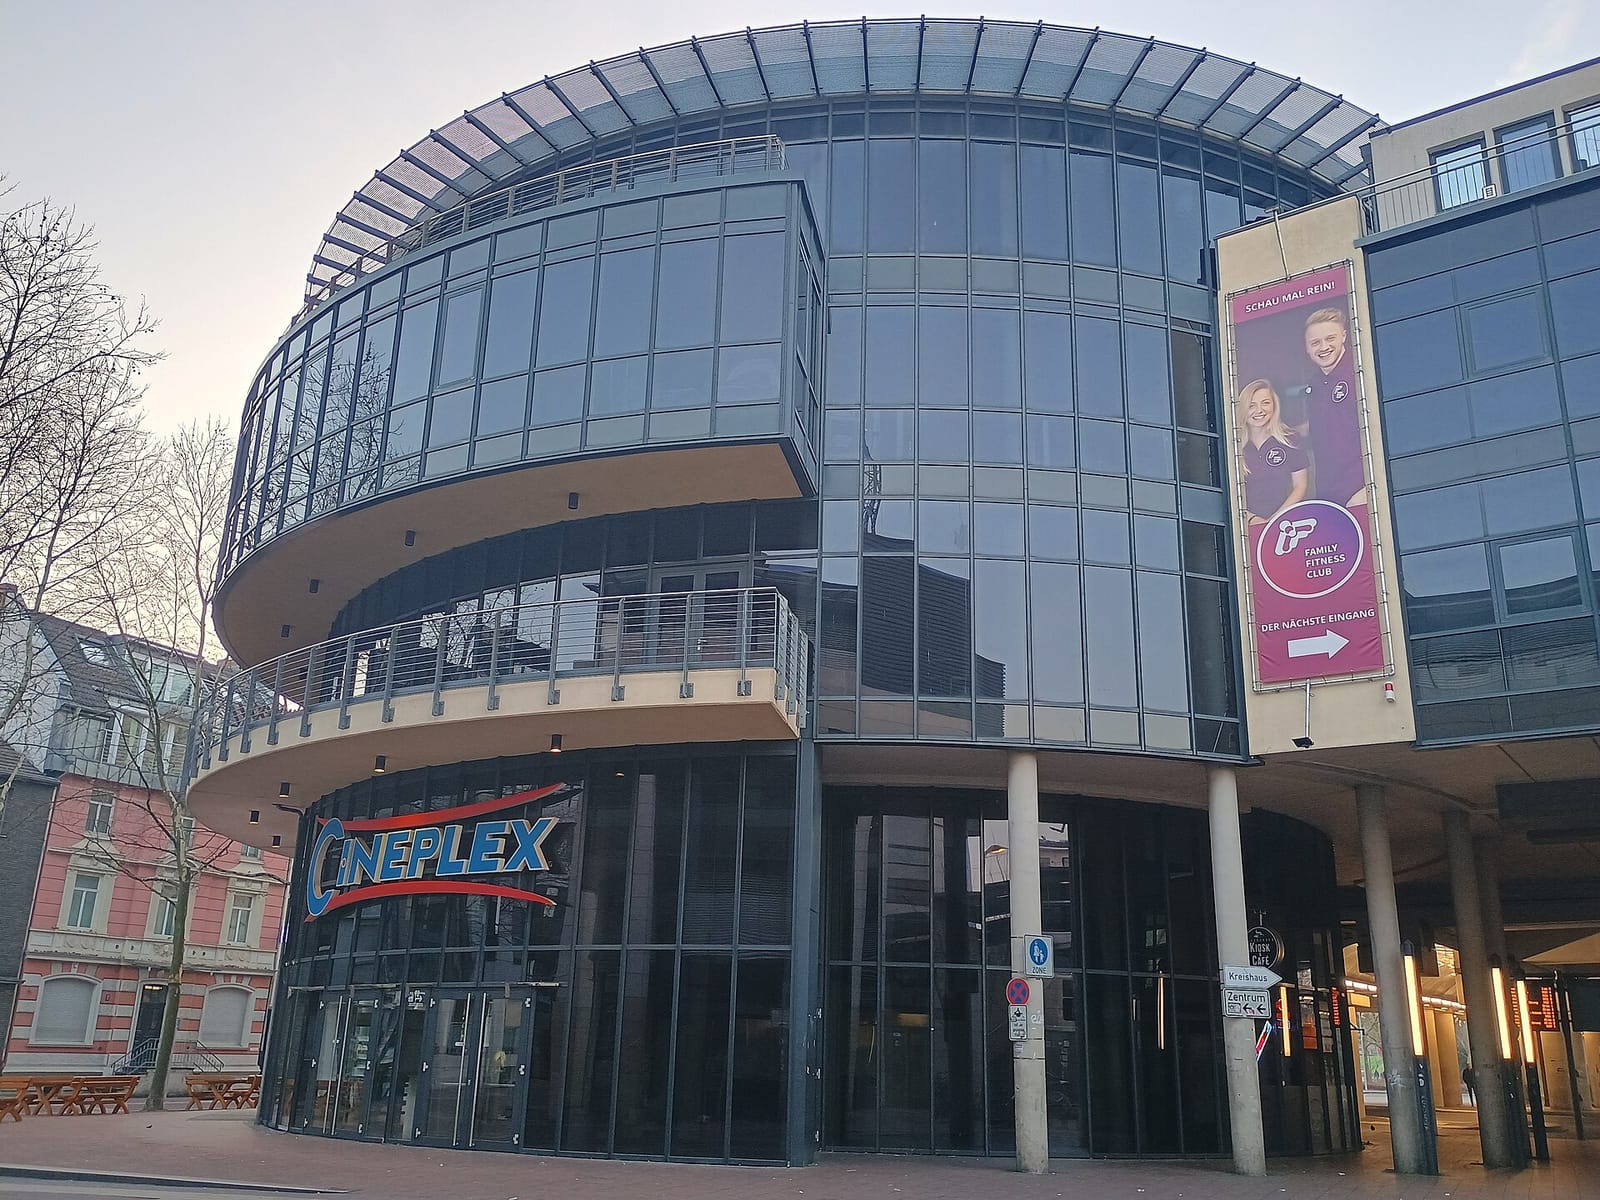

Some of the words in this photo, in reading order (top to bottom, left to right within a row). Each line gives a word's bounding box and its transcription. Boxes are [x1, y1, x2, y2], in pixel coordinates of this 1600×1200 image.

[1245, 297, 1279, 313] SCHAU
[1282, 290, 1304, 303] MAL
[1307, 281, 1335, 296] REIN!
[1305, 544, 1338, 557] FAMILY
[1305, 554, 1346, 568] FITNESS
[1306, 567, 1332, 578] CLUB
[1261, 623, 1280, 632] DER
[1282, 615, 1326, 629] NÄCHSTE
[1328, 608, 1375, 623] EINGANG
[306, 816, 560, 917] CINEPLEX
[1032, 967, 1047, 975] ZONE
[1228, 972, 1268, 982] Kreishaus
[1227, 991, 1266, 1002] Zentrum
